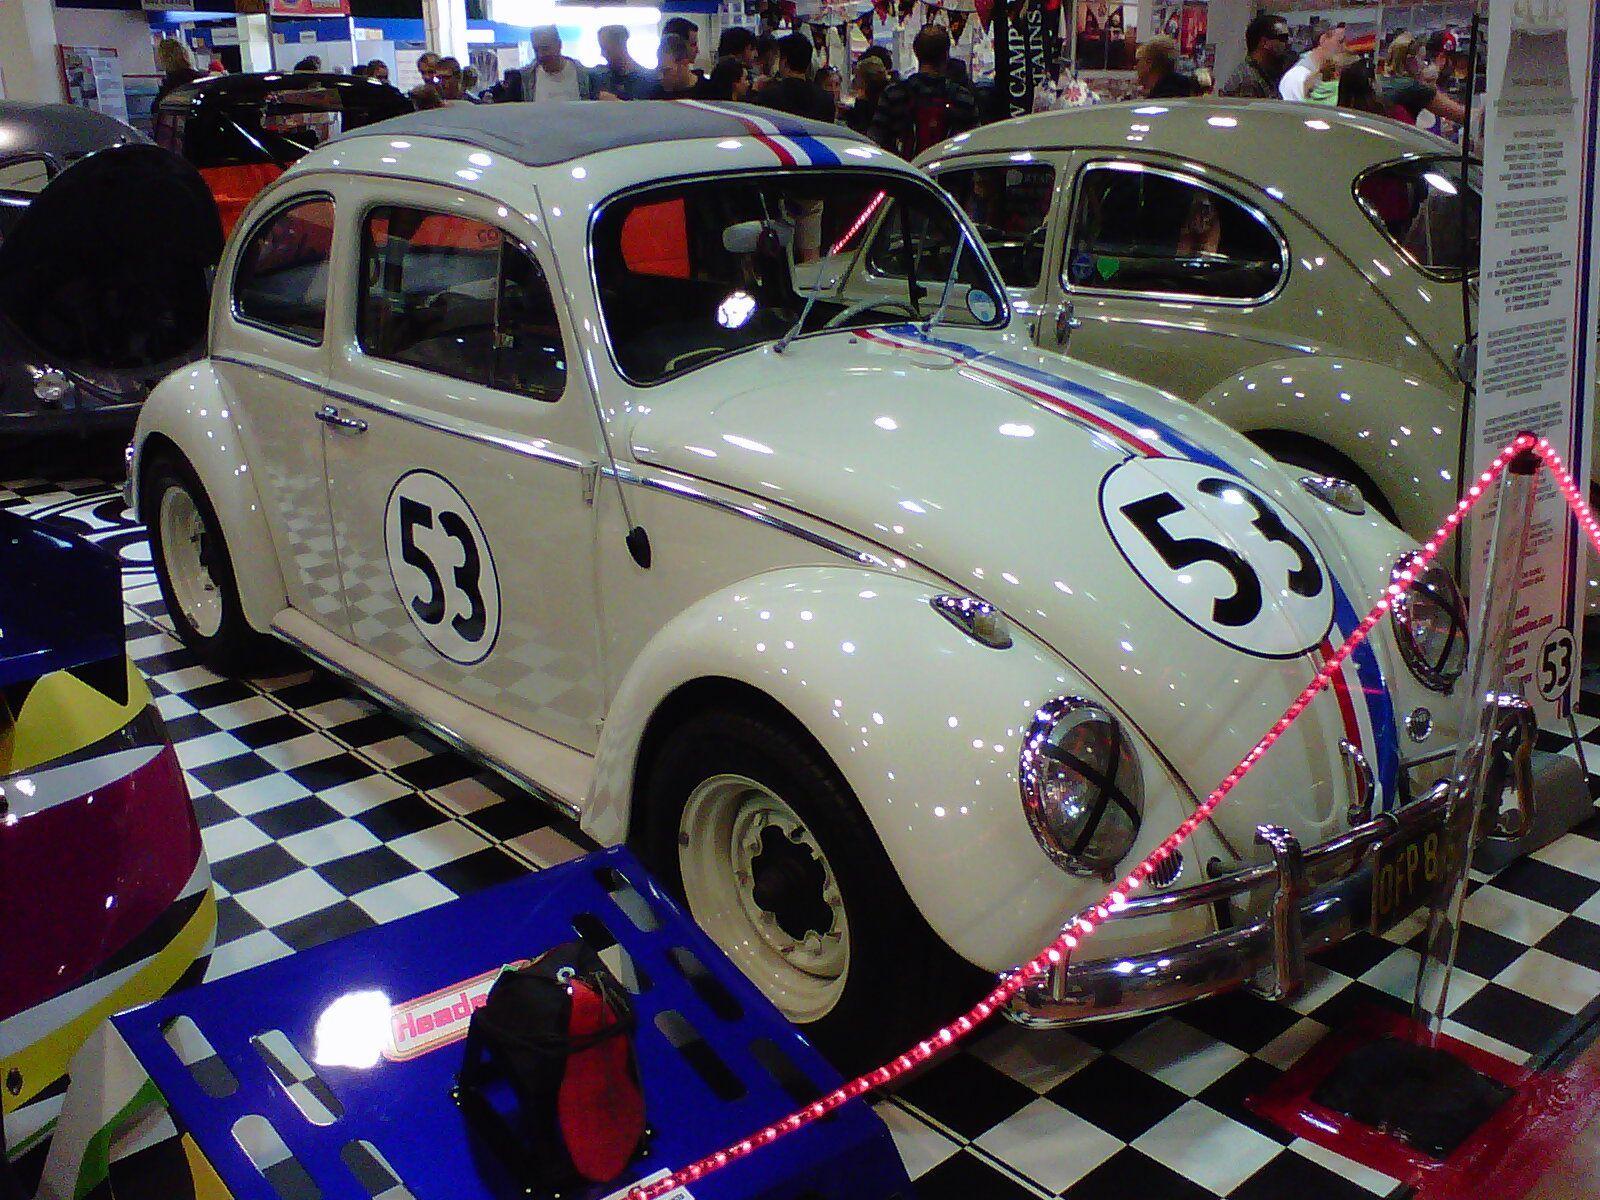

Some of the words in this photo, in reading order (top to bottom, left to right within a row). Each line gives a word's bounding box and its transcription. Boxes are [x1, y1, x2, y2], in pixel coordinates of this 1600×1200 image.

[400, 495, 487, 642] 53
[1119, 477, 1324, 626] 53
[1542, 637, 1573, 693] 53
